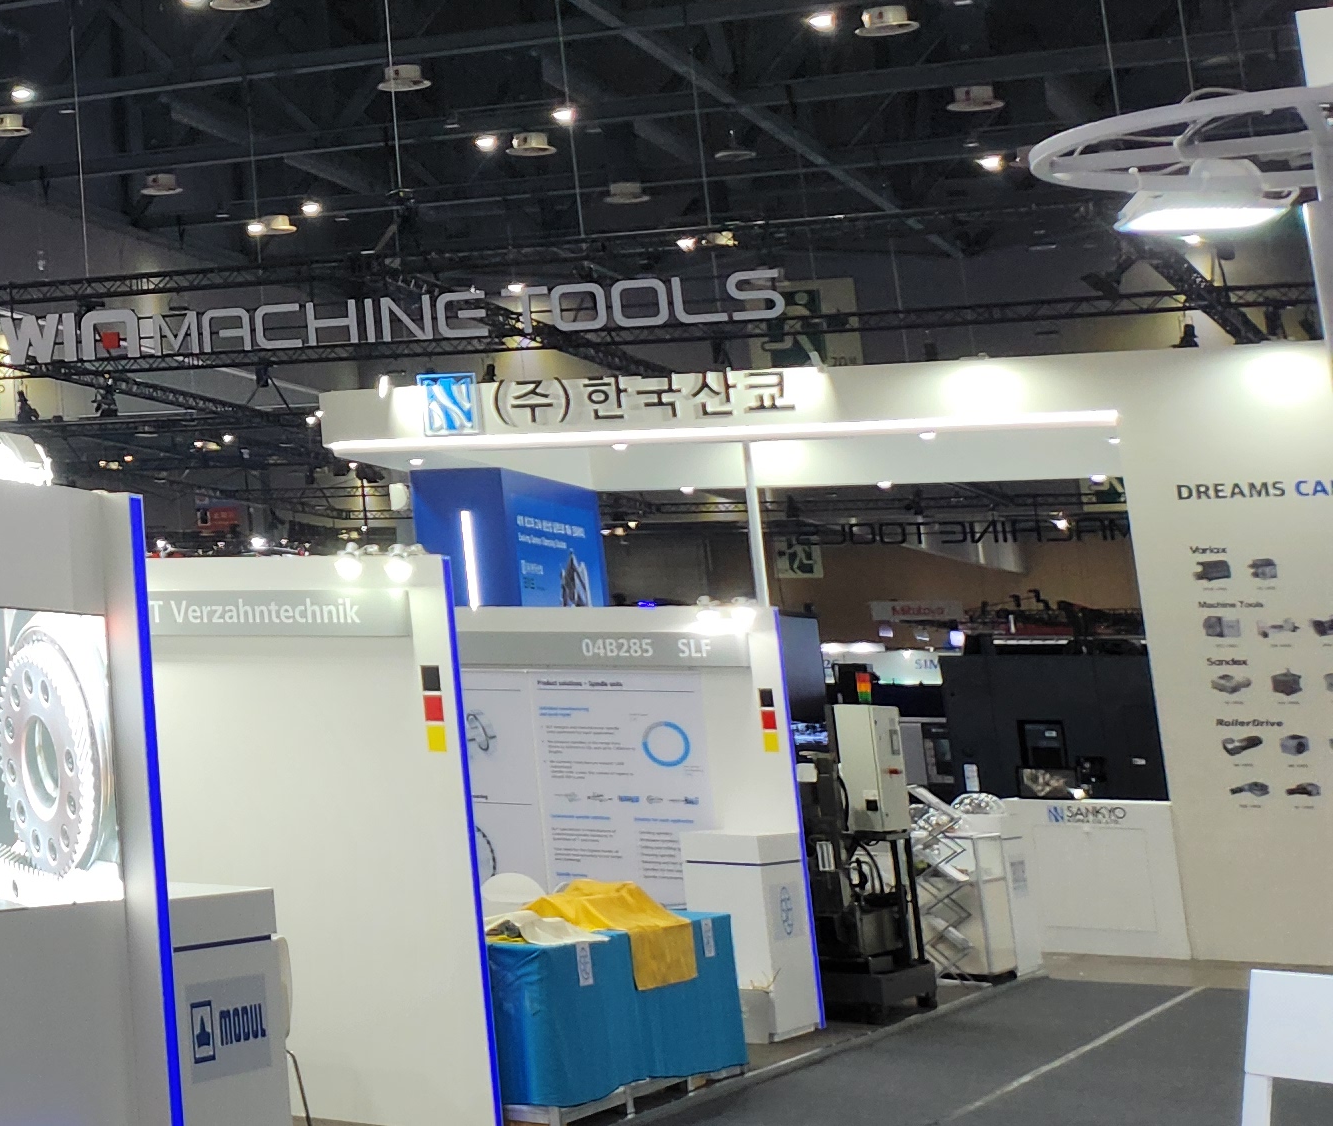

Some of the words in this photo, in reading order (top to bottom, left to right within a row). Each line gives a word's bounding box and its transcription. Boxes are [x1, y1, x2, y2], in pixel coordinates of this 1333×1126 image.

[153, 289, 489, 356] MACHINE
[501, 268, 786, 333] TOOLS
[1176, 481, 1286, 501] DREAMS
[170, 597, 362, 624] Verzahntechnik
[1197, 601, 1237, 609] Machine
[1238, 600, 1264, 609] Tools
[582, 638, 654, 657] 04B285
[677, 638, 712, 657] SLF
